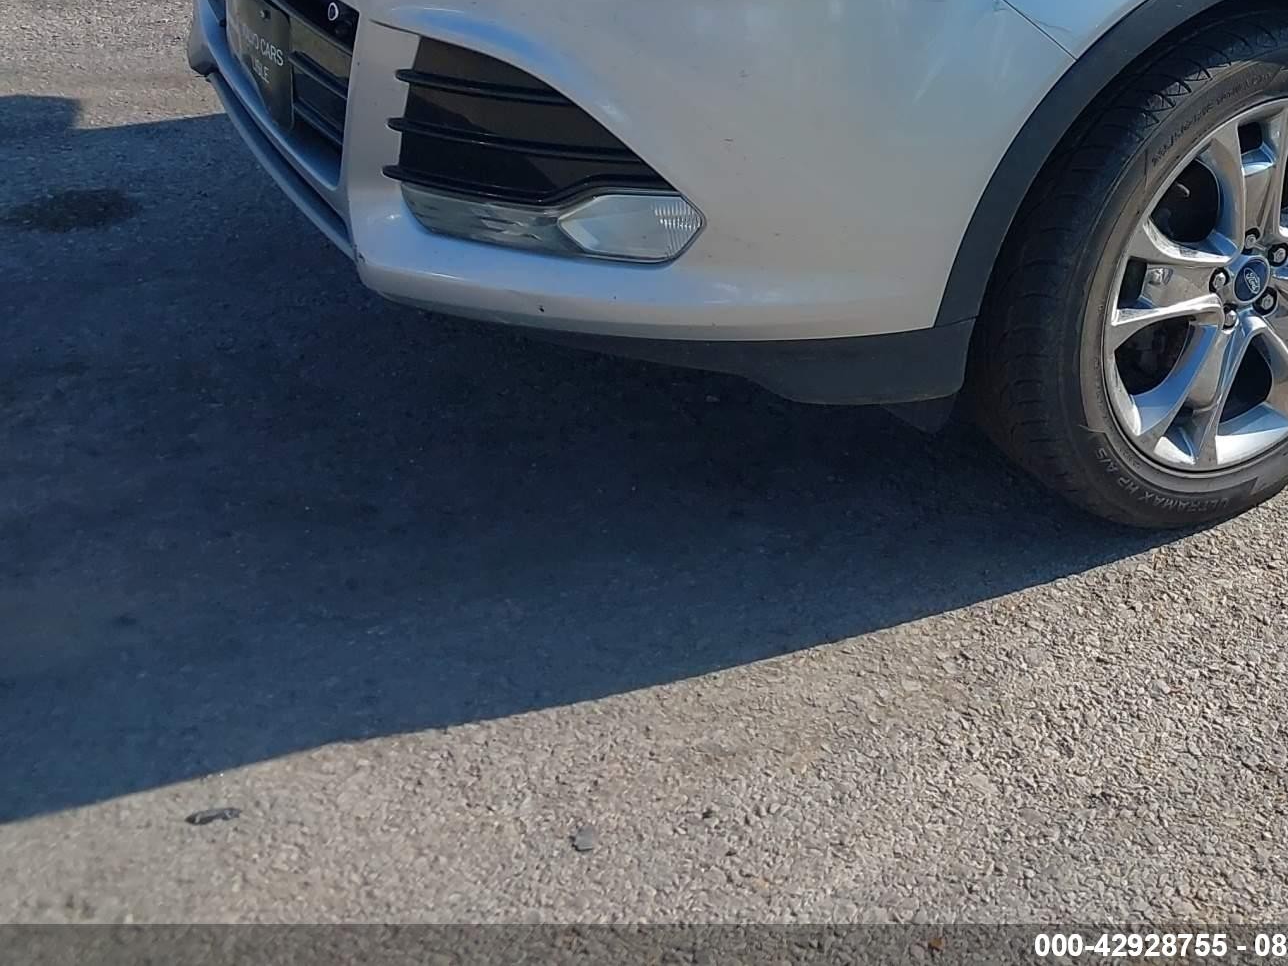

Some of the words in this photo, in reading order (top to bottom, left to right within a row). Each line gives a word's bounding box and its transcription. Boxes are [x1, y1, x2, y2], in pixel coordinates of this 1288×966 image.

[260, 38, 284, 67] CARS
[1095, 446, 1118, 474] A/S
[1116, 475, 1140, 496] HP
[1138, 490, 1230, 514] ULTRAMAX
